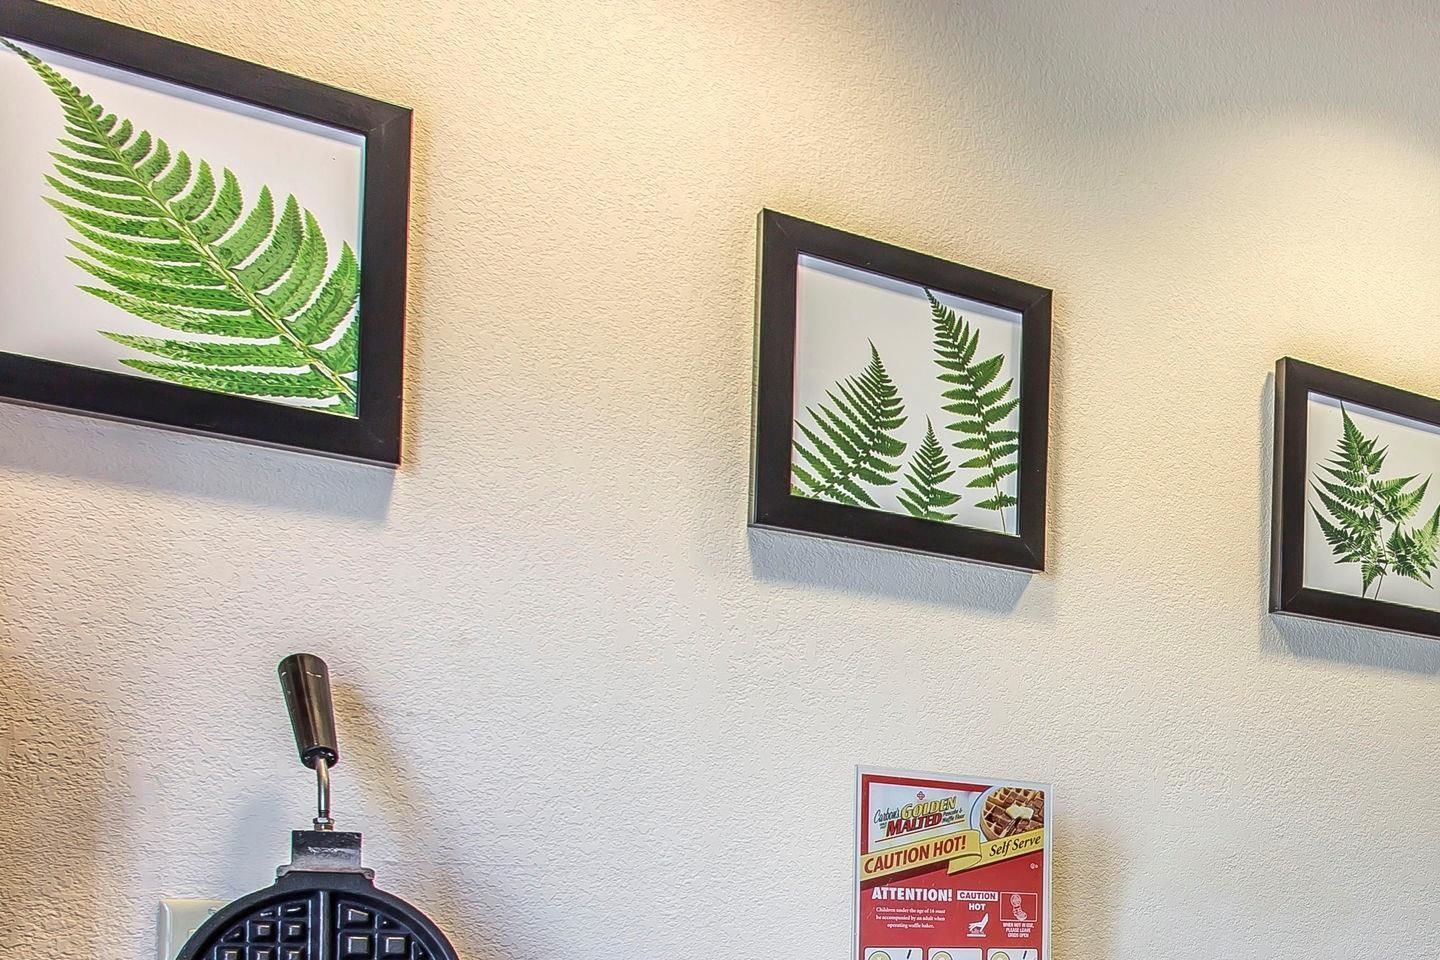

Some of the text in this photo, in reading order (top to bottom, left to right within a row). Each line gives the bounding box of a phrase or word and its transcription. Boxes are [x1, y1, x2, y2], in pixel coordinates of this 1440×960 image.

[901, 796, 957, 820] GOLDEN
[886, 813, 942, 837] MALTED
[864, 835, 966, 874] CAUTION HOT!
[989, 834, 1042, 857] Self Serve
[872, 887, 953, 902] ATTENTION!
[959, 892, 997, 900] CAUTION
[968, 903, 986, 911] HOT
